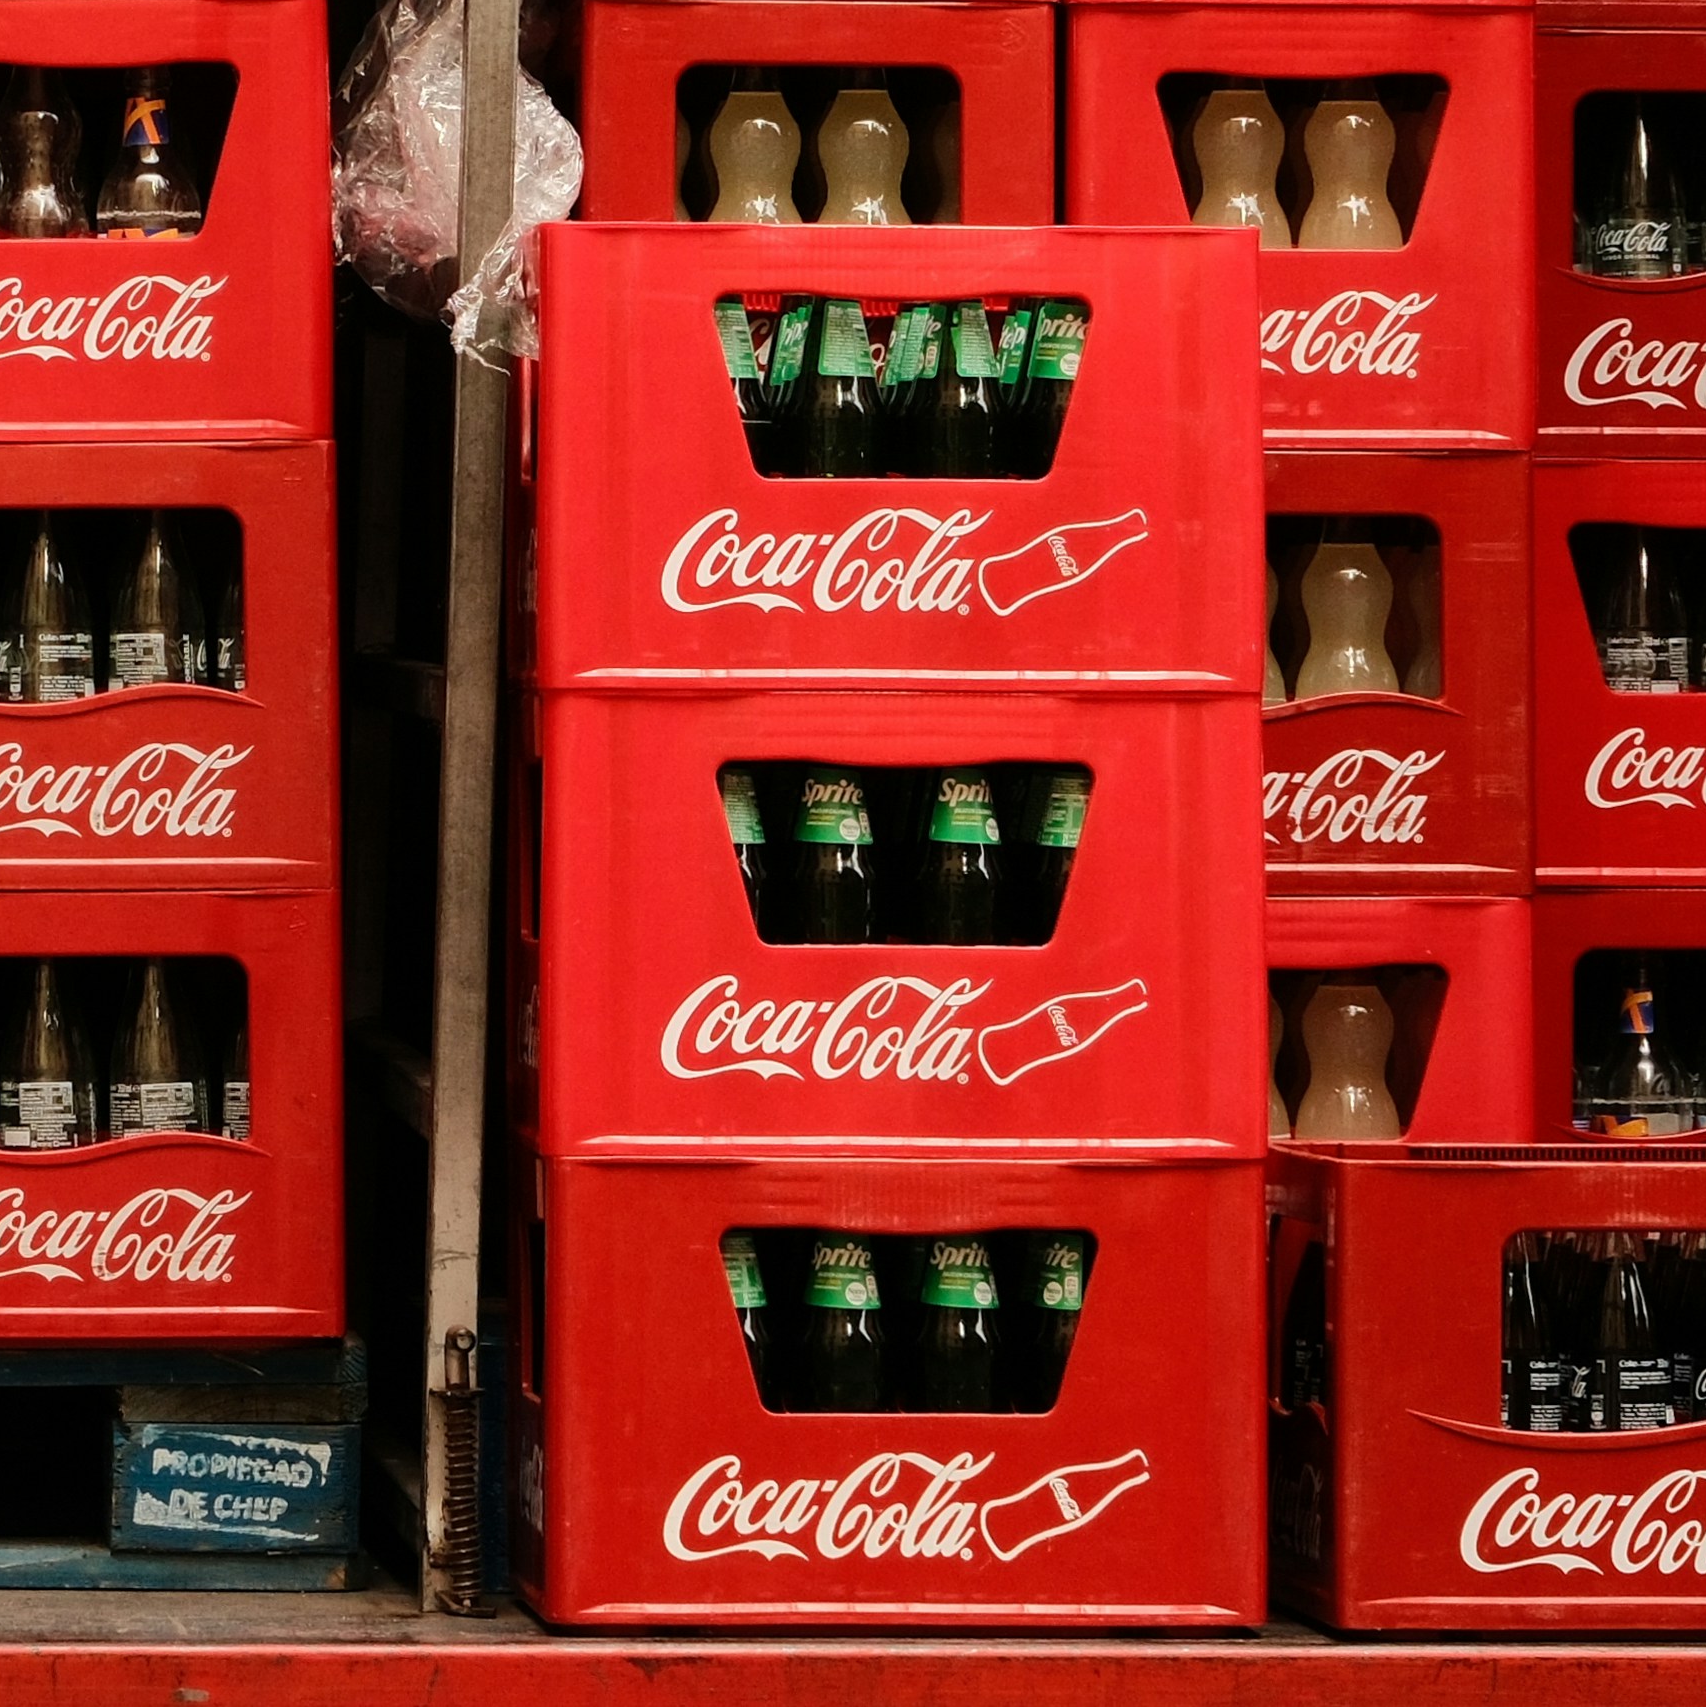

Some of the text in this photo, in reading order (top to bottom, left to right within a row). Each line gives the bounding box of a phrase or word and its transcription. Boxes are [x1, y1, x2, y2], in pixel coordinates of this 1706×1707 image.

[1261, 291, 1436, 378] a-Cola
[661, 509, 993, 614] Coca-Cola
[801, 778, 864, 807] Sprite
[1263, 749, 1444, 843] a-Cola
[661, 975, 993, 1081] Coca-Cola
[811, 1242, 872, 1270] Sprite
[169, 1488, 289, 1522] DE CHEP
[663, 1452, 995, 1561] Coca-Cola
